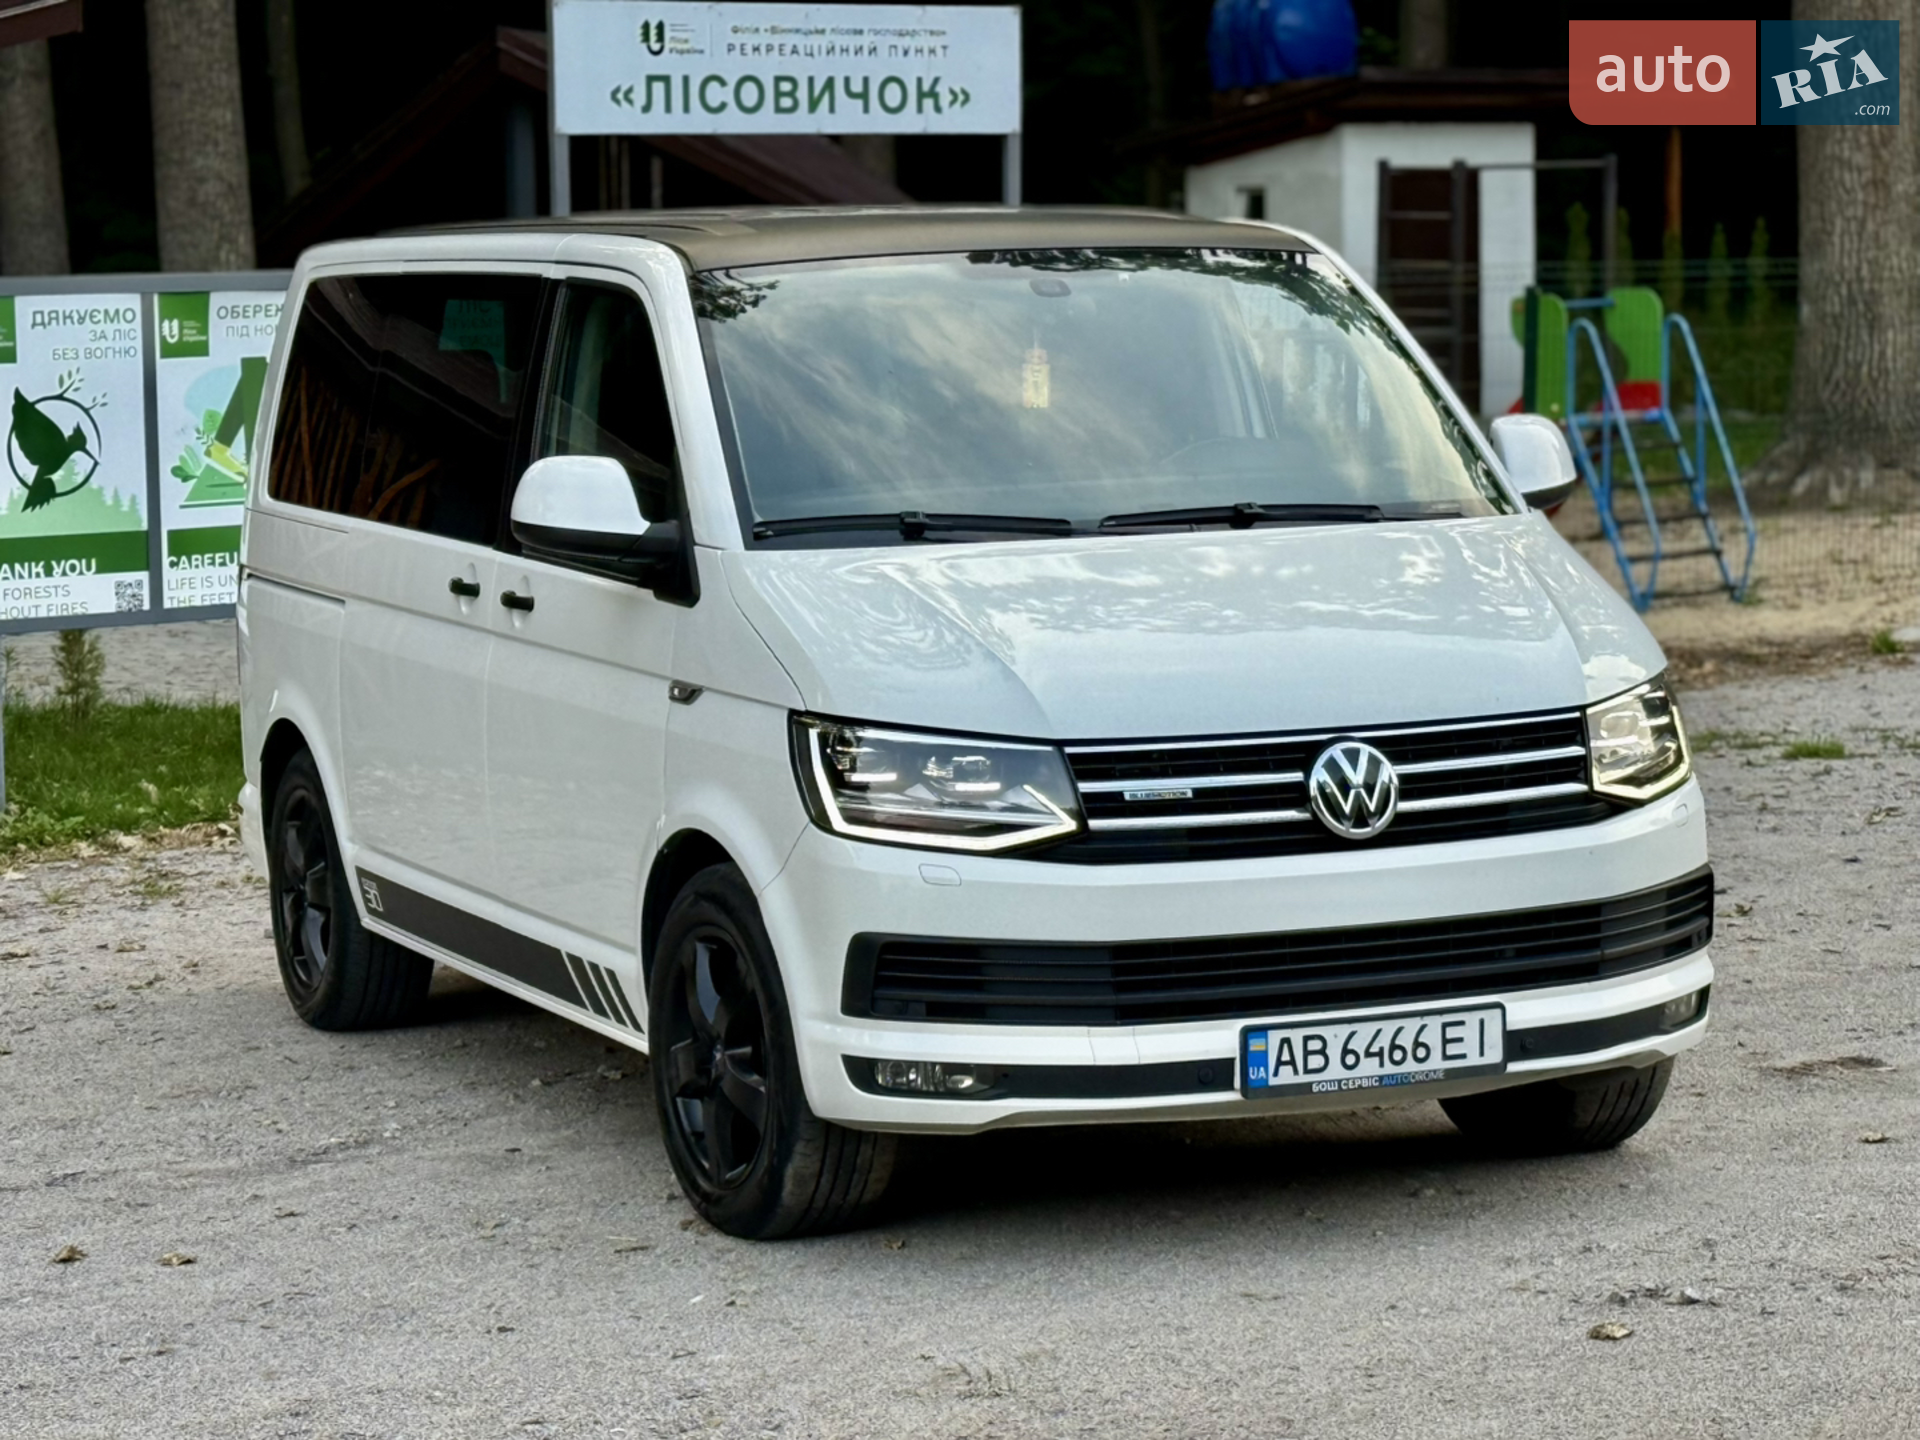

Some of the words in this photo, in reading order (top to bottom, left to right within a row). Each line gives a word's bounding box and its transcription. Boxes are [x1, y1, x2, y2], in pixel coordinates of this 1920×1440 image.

[726, 41, 878, 60] РЕКРЕАЦІЙНИЙ
[888, 44, 949, 58] ПУНКТ
[610, 74, 971, 115] «ЛІСОВИЧОК»
[31, 307, 137, 330] ДЯКУЄМО
[88, 329, 109, 342] ЗА
[111, 328, 138, 341] ЛІС
[226, 325, 250, 338] ПІД
[52, 347, 79, 361] БЕЗ
[83, 345, 138, 360] ВОГНЮ
[51, 558, 97, 577] YOU
[167, 576, 197, 591] LIFE
[201, 575, 214, 589] IS
[3, 584, 71, 601] FORESTS
[47, 602, 88, 616] FIRES
[1249, 1066, 1267, 1080] UA
[1312, 1081, 1339, 1093] БОШ
[1340, 1076, 1380, 1090] СЕРВІС
